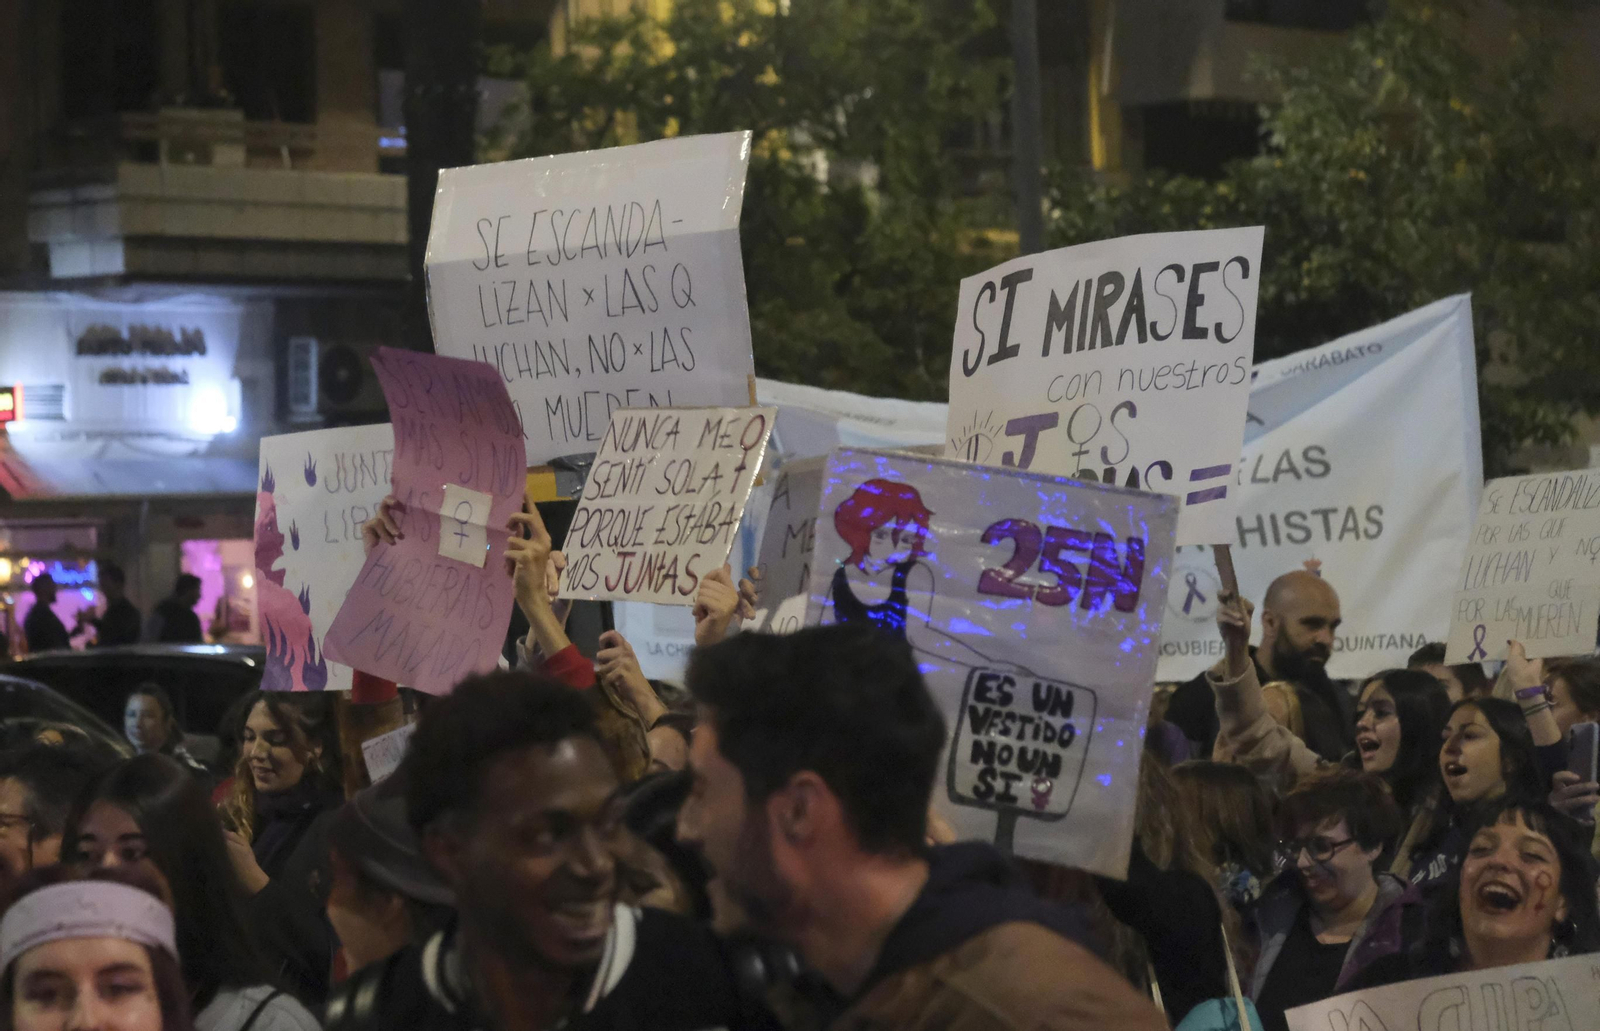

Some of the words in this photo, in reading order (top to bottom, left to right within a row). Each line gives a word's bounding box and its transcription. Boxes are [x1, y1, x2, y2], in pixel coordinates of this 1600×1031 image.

[473, 214, 512, 271] SE
[527, 199, 683, 266] ESCANDA-
[604, 265, 659, 317] LAS
[671, 262, 696, 309] Q
[962, 267, 1034, 377] SI
[1042, 256, 1250, 357] MIRASES
[588, 332, 626, 374] NO
[650, 326, 696, 371] LAS
[1047, 370, 1102, 403] con
[1117, 356, 1246, 391] nuestros
[545, 389, 673, 444] MUE
[600, 414, 681, 455] NUNCA
[697, 416, 741, 450] ME
[325, 449, 394, 494] JUNT
[1250, 445, 1332, 484] LAS
[1509, 474, 1600, 515] ESCANDALIZ
[325, 501, 382, 544] LIB
[566, 504, 655, 554] PORQUE
[1236, 504, 1384, 549] HISTAS
[1475, 522, 1502, 545] POR
[1508, 520, 1531, 543] LAS
[1539, 516, 1569, 541] QUE
[564, 552, 602, 593] MOS
[605, 550, 701, 597] JUNTAS
[977, 518, 1145, 613] 25N
[1464, 548, 1537, 591] LUCHAN
[1458, 597, 1486, 622] POR
[1494, 596, 1518, 622] LAS
[1515, 600, 1585, 641] MUEREN
[1332, 631, 1428, 654] QUINTANA
[973, 672, 1016, 707] ES
[1032, 682, 1074, 719] UN
[973, 767, 1023, 805] SI
